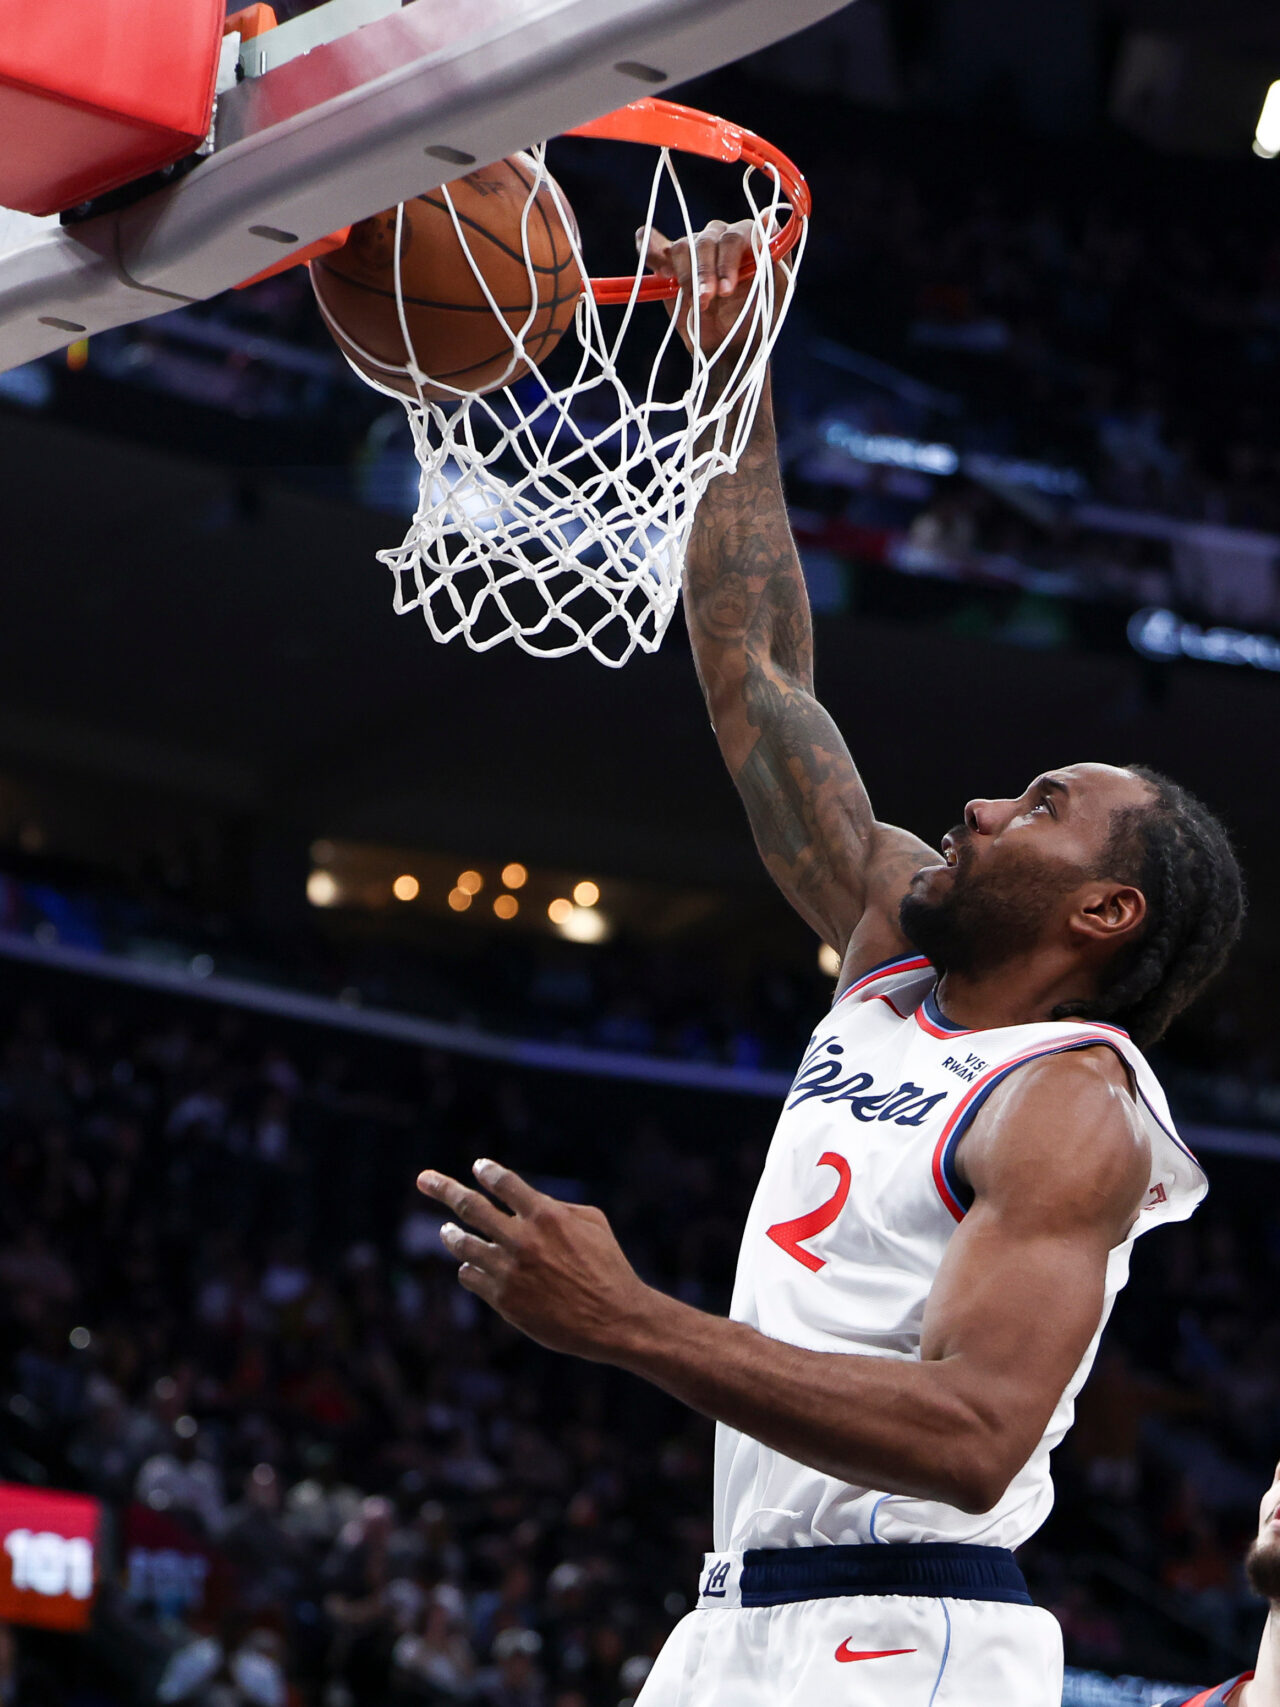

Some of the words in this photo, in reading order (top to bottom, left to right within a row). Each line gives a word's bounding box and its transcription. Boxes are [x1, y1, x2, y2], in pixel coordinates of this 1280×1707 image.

[941, 1056, 978, 1082] RWAN
[766, 1151, 852, 1273] 2
[4, 1528, 94, 1599] 101
[702, 1559, 731, 1598] LA
